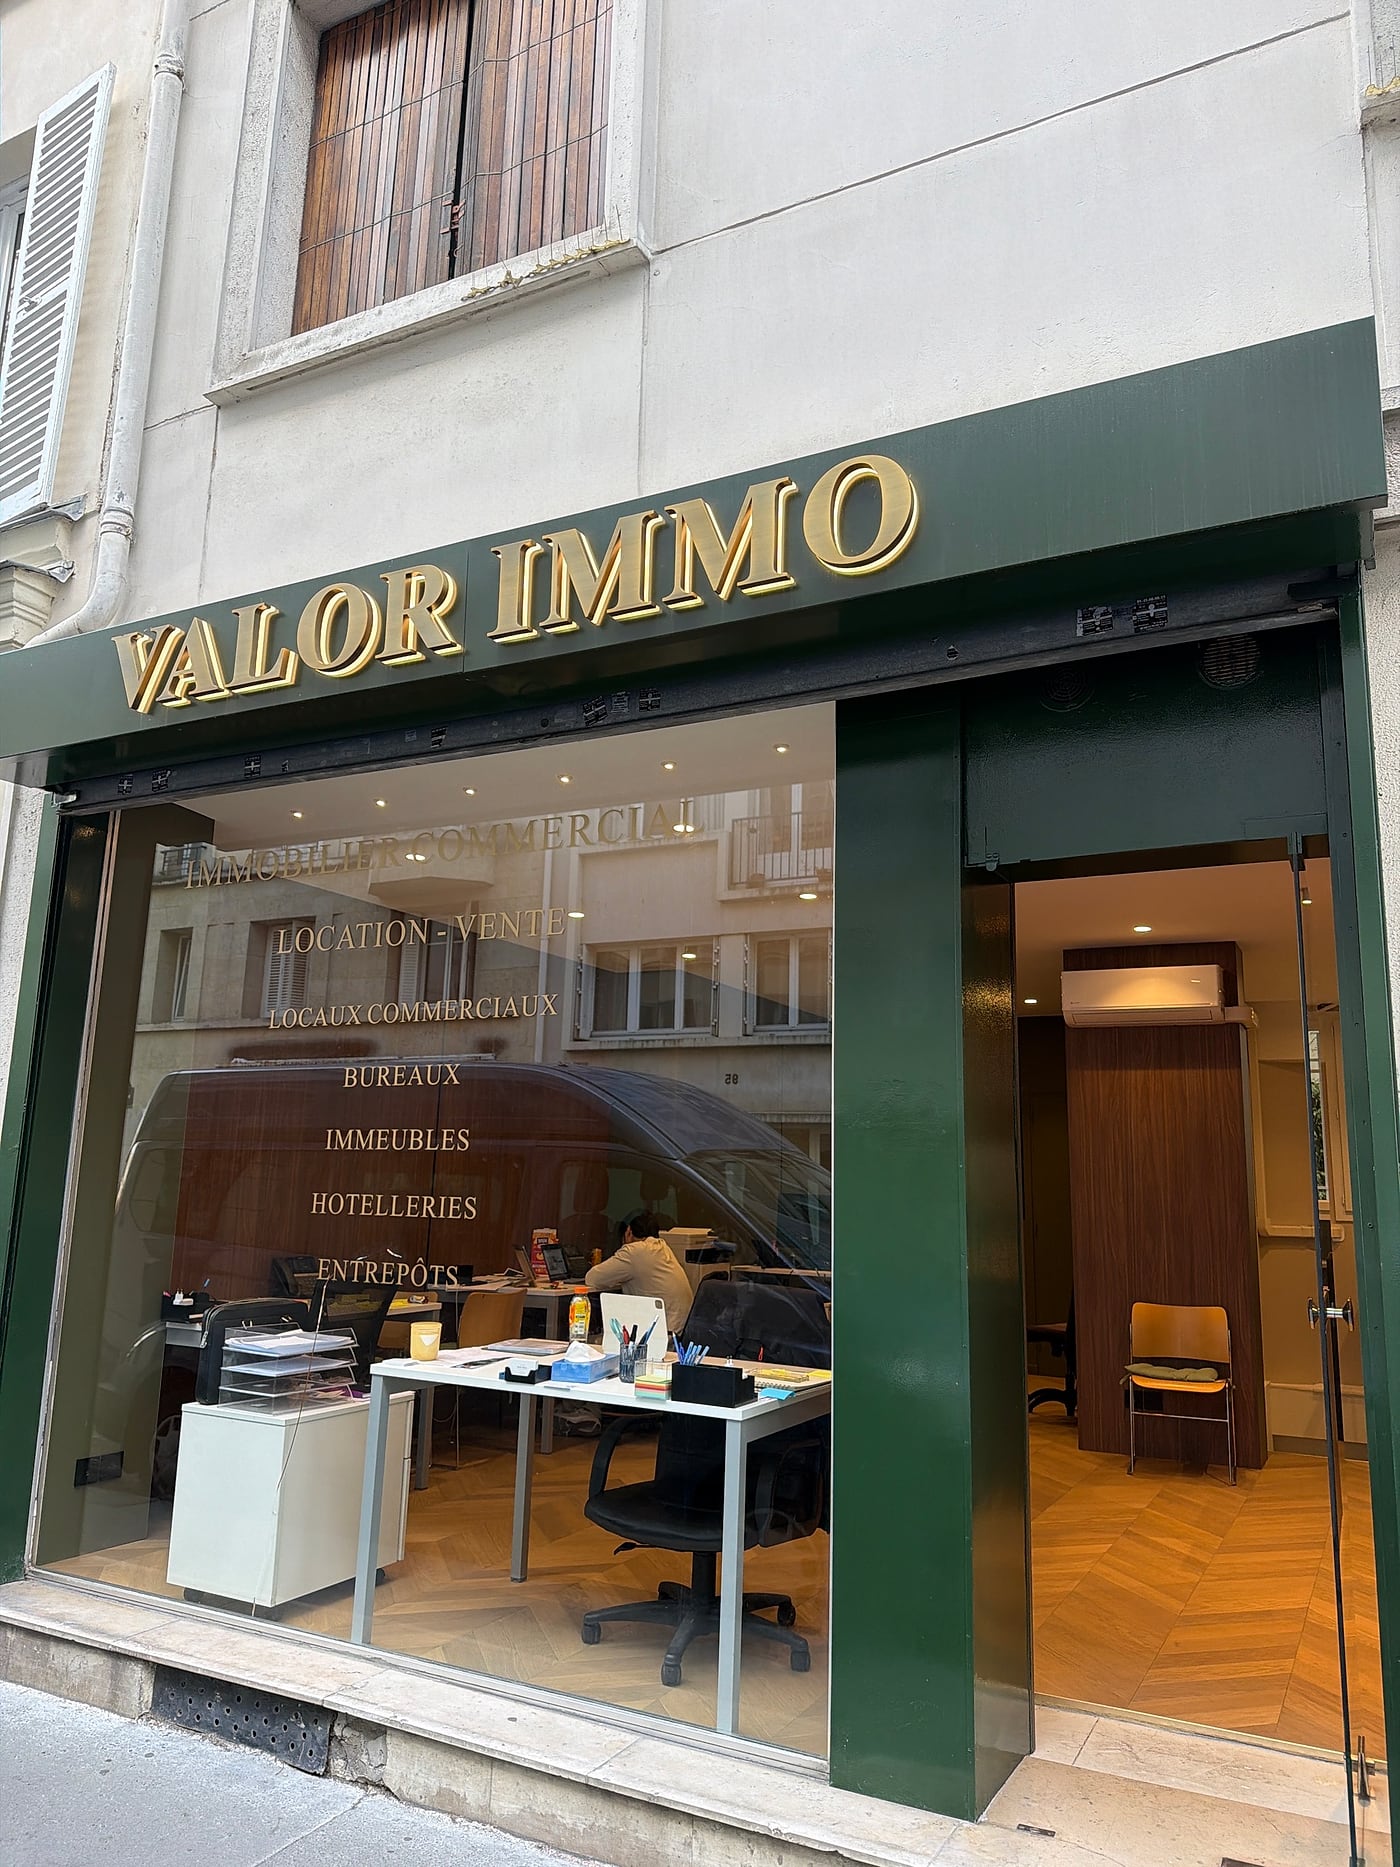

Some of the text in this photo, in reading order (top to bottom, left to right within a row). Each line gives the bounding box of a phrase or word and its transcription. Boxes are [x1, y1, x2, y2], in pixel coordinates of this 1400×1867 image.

[111, 454, 920, 713] VALOR IMMO
[184, 799, 705, 889] IMMOBILIER COMMERCIAL
[277, 918, 431, 955] LOCATION
[455, 907, 566, 943] VENTE
[269, 993, 558, 1030] LOCAUX COMMERCIAUX
[342, 1063, 461, 1089] BUREAUX
[325, 1128, 470, 1152] IMMEUBLES
[310, 1192, 477, 1220] HOTELLERIES
[316, 1257, 460, 1288] ENTREPÔTS
